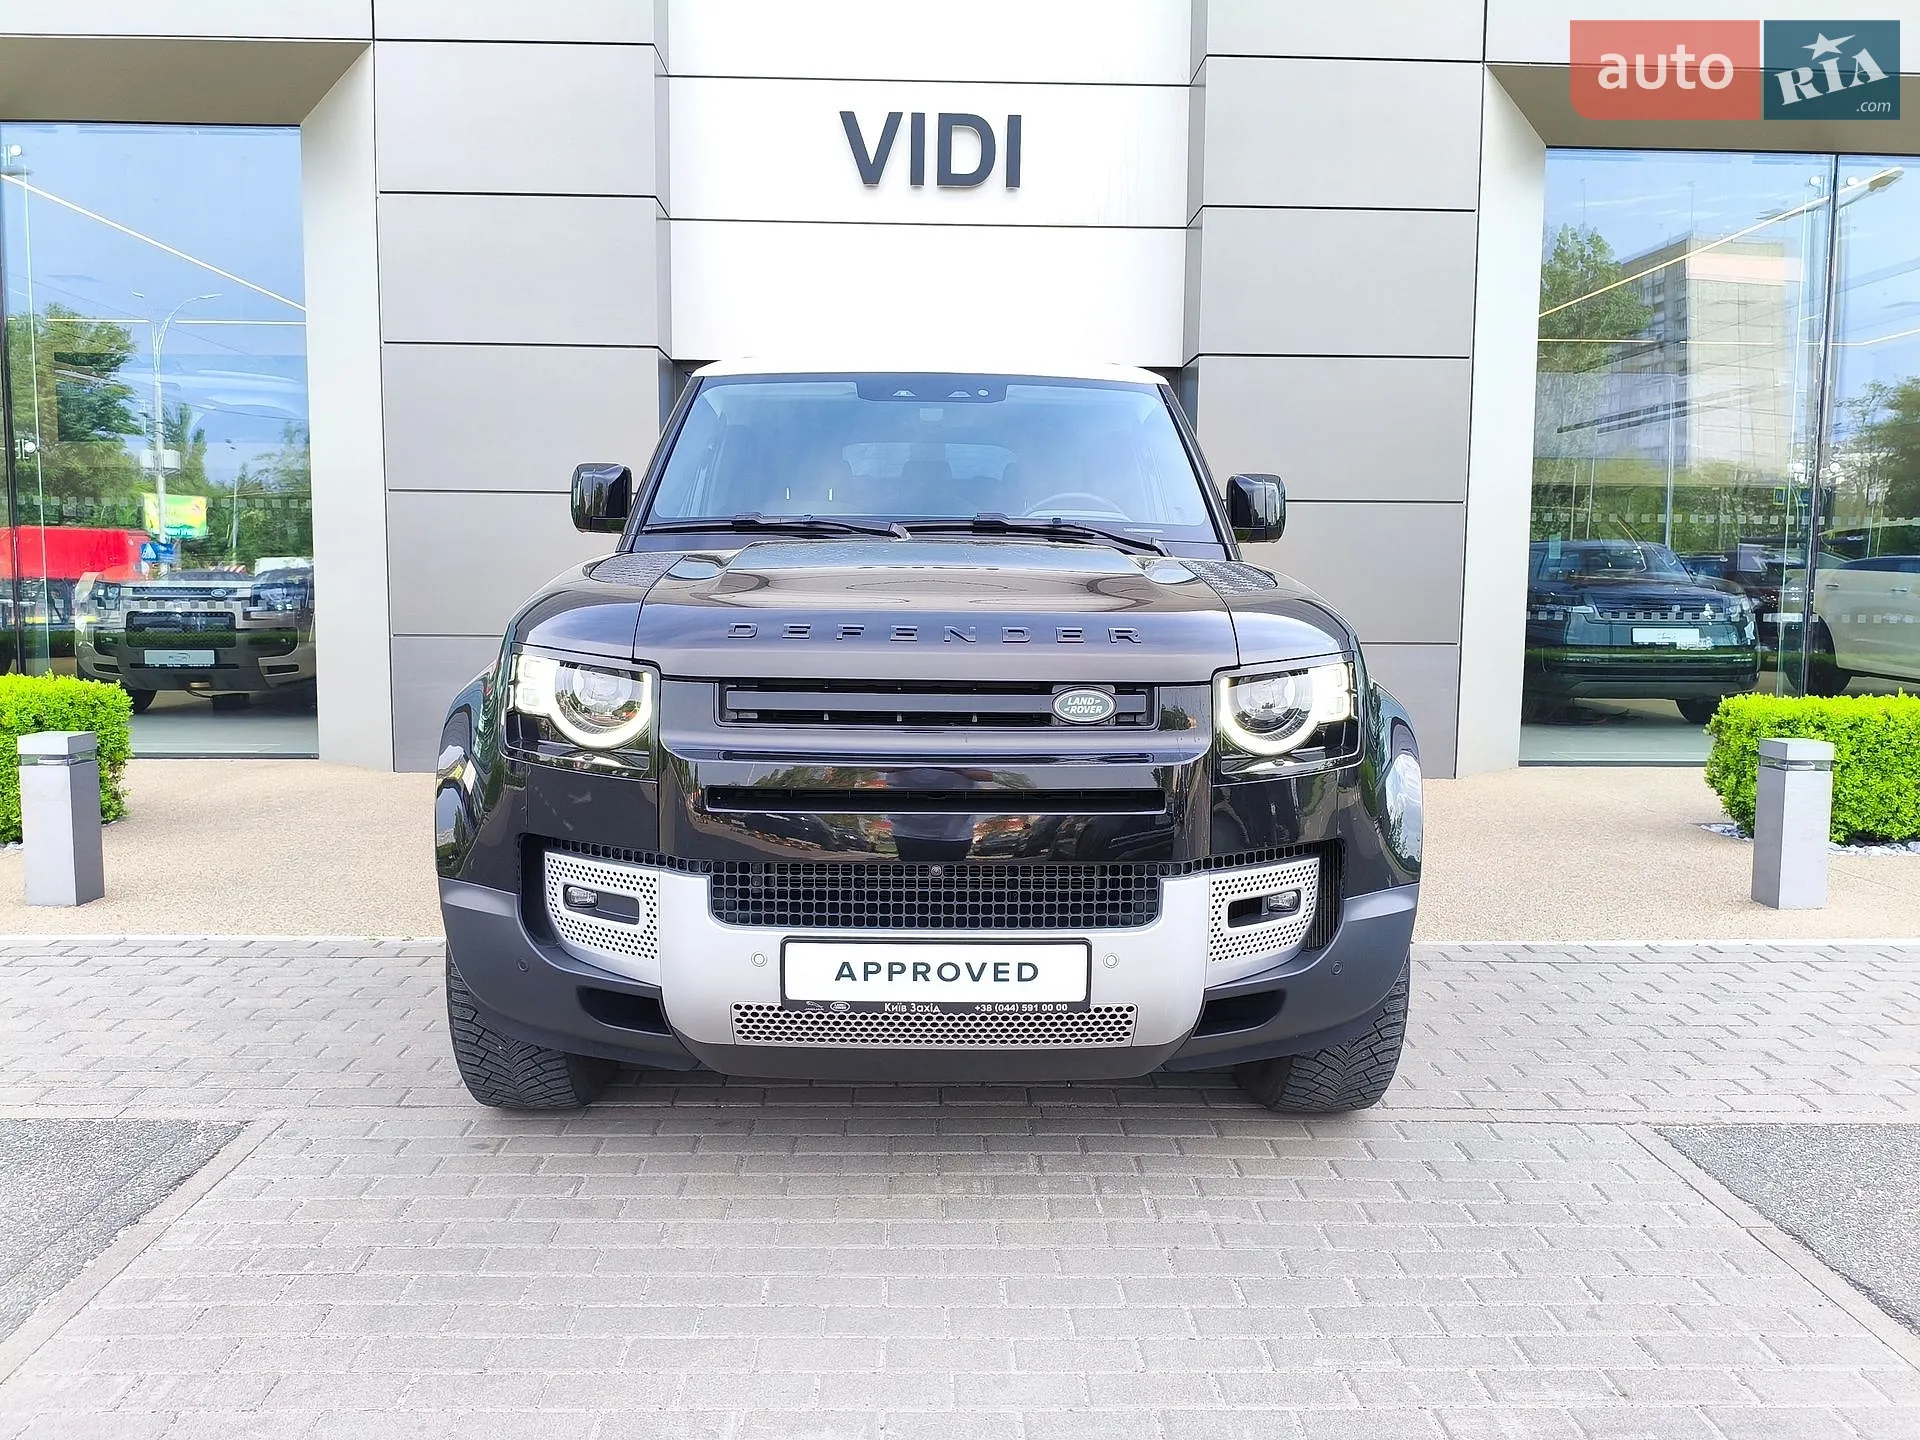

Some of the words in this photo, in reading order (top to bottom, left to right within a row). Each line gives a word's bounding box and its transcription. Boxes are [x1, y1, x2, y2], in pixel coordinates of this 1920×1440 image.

[839, 110, 1022, 188] VIDI
[727, 622, 1142, 644] DEFENDER
[1067, 696, 1095, 706] LAND
[1069, 705, 1103, 714] ROVER
[834, 961, 1039, 982] APPROVED
[884, 1002, 907, 1012] Київ
[910, 1002, 941, 1014] Захід
[974, 1003, 993, 1012] +38
[994, 1002, 1019, 1013] (044)
[1021, 1003, 1039, 1012] 591
[1041, 1003, 1054, 1012] 00
[1055, 1003, 1068, 1012] 00
